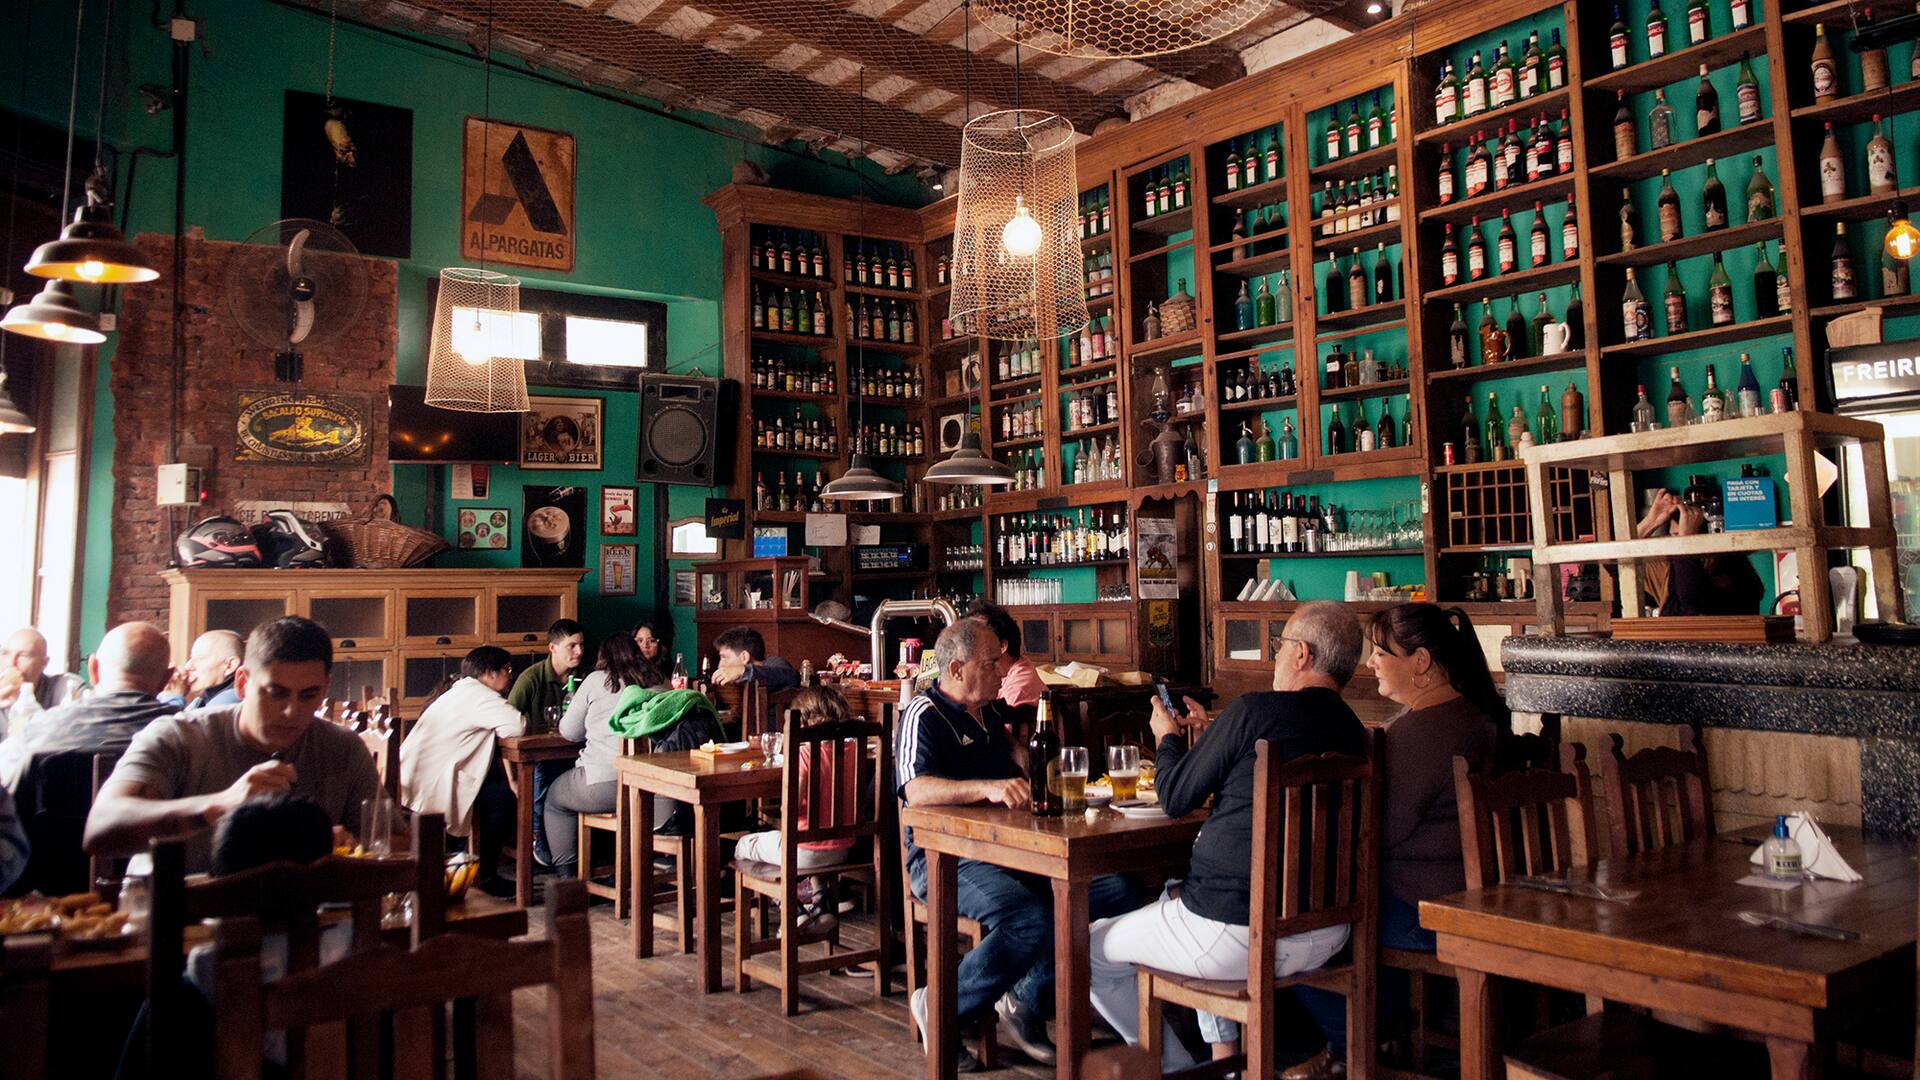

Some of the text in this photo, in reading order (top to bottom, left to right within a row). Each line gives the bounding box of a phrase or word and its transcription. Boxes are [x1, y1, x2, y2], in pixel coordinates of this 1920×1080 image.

[470, 231, 565, 260] ALPARGATAS
[262, 407, 301, 420] BACALAO
[303, 407, 346, 426] SUPERIOR
[527, 452, 595, 462] LAGER BIER
[710, 510, 740, 528] Imperial
